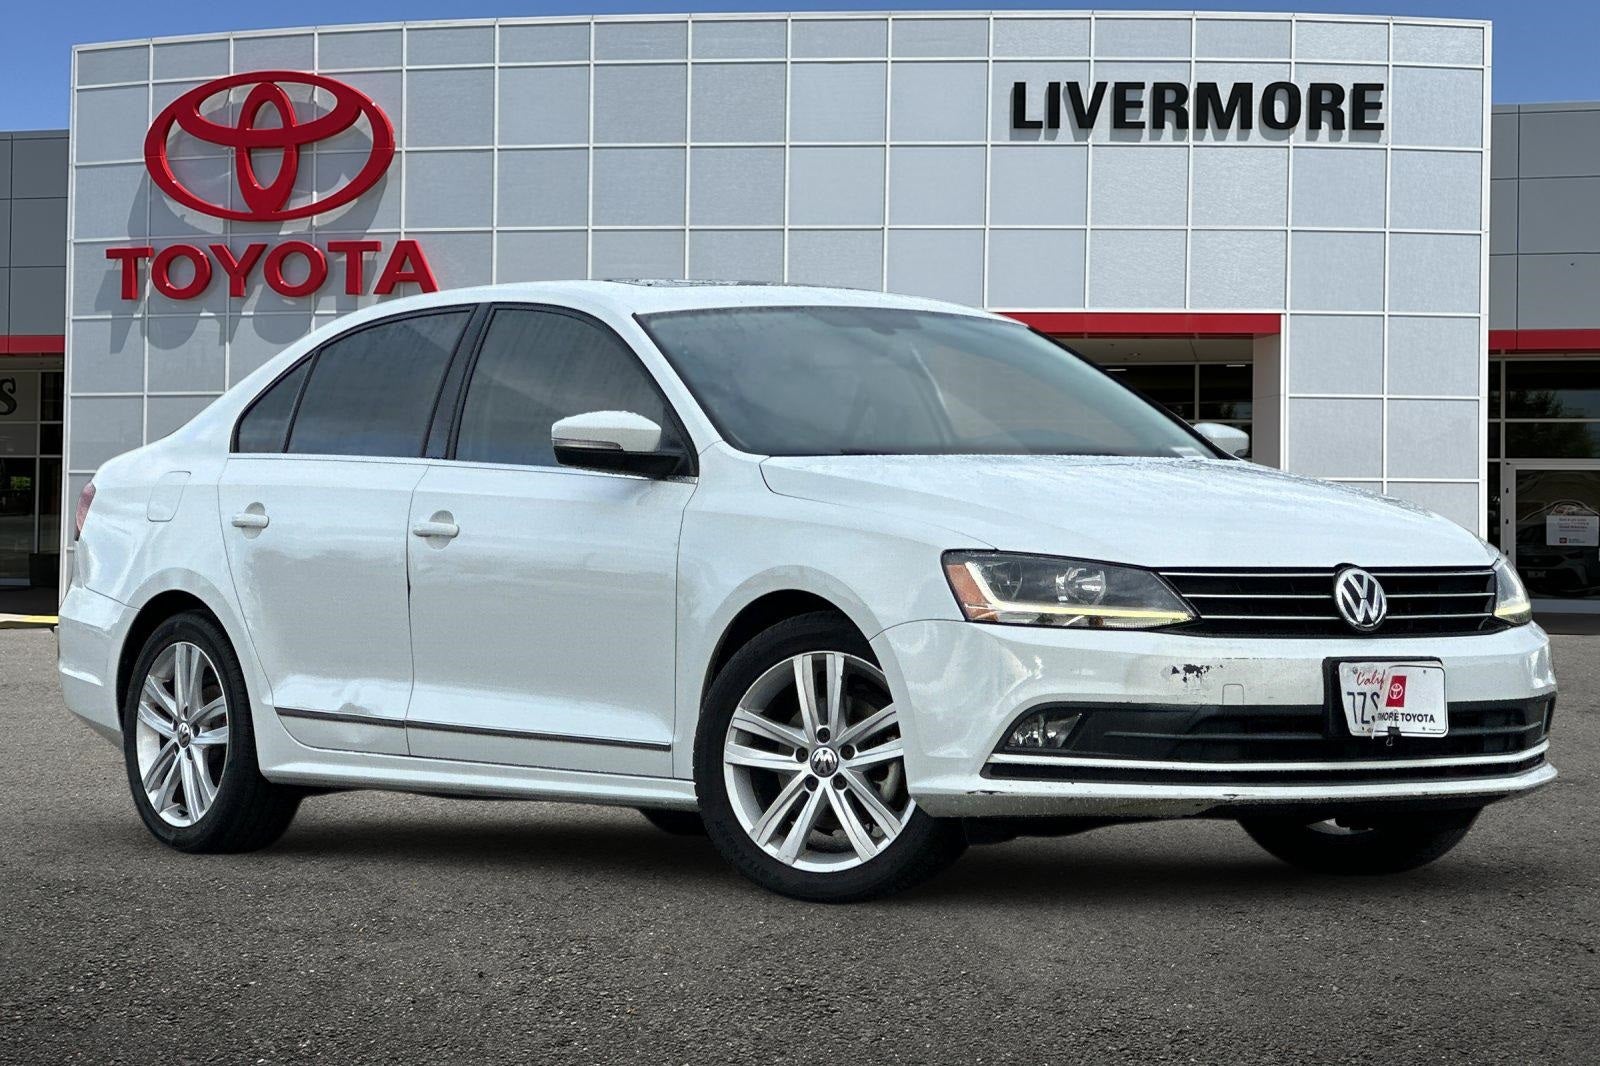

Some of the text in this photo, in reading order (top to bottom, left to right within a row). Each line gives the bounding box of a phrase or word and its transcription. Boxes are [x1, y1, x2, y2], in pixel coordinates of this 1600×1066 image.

[1012, 81, 1385, 131] LIVERMORE
[105, 239, 439, 300] TOYOTA
[1335, 567, 1387, 628] VW
[1400, 713, 1435, 723] TOYOTA
